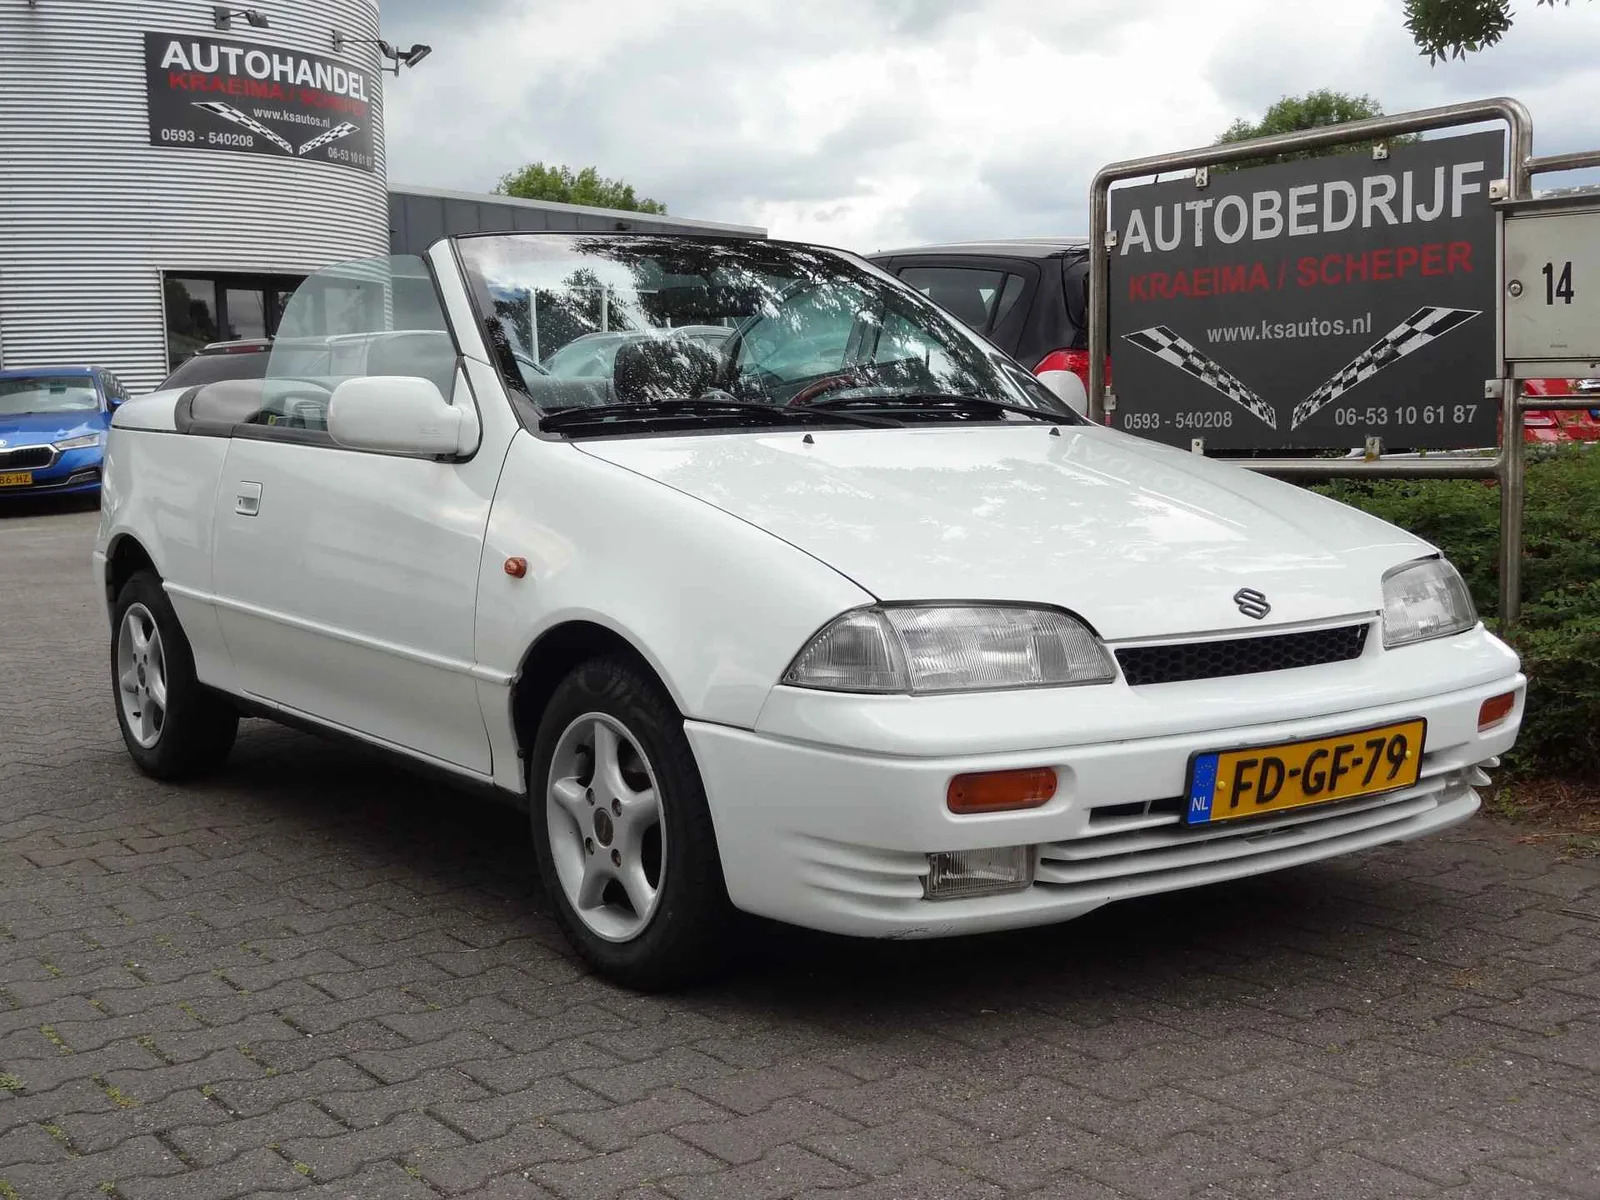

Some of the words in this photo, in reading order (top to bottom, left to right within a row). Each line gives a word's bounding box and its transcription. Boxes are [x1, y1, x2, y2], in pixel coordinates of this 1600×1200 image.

[160, 41, 369, 102] AUTOHANDEL
[168, 72, 285, 100] KRAEIMA
[253, 108, 331, 128] www.ksautos.nl
[161, 129, 196, 142] 0593
[208, 131, 254, 147] 540208
[1120, 161, 1485, 256] AUTOBEDRIJF
[1128, 263, 1270, 302] KRAEIMA
[1297, 241, 1474, 287] SCHEPER
[1542, 262, 1575, 305] 14
[1207, 312, 1372, 344] www.ksautos.nl
[1124, 413, 1160, 429] 0593
[1175, 411, 1233, 429] 540208
[1334, 409, 1388, 426] 06-53
[1396, 407, 1417, 424] 10
[1423, 405, 1445, 424] 61
[1453, 404, 1478, 424] 87
[1230, 734, 1408, 808] FD-GF-79
[1191, 796, 1209, 812] NL
